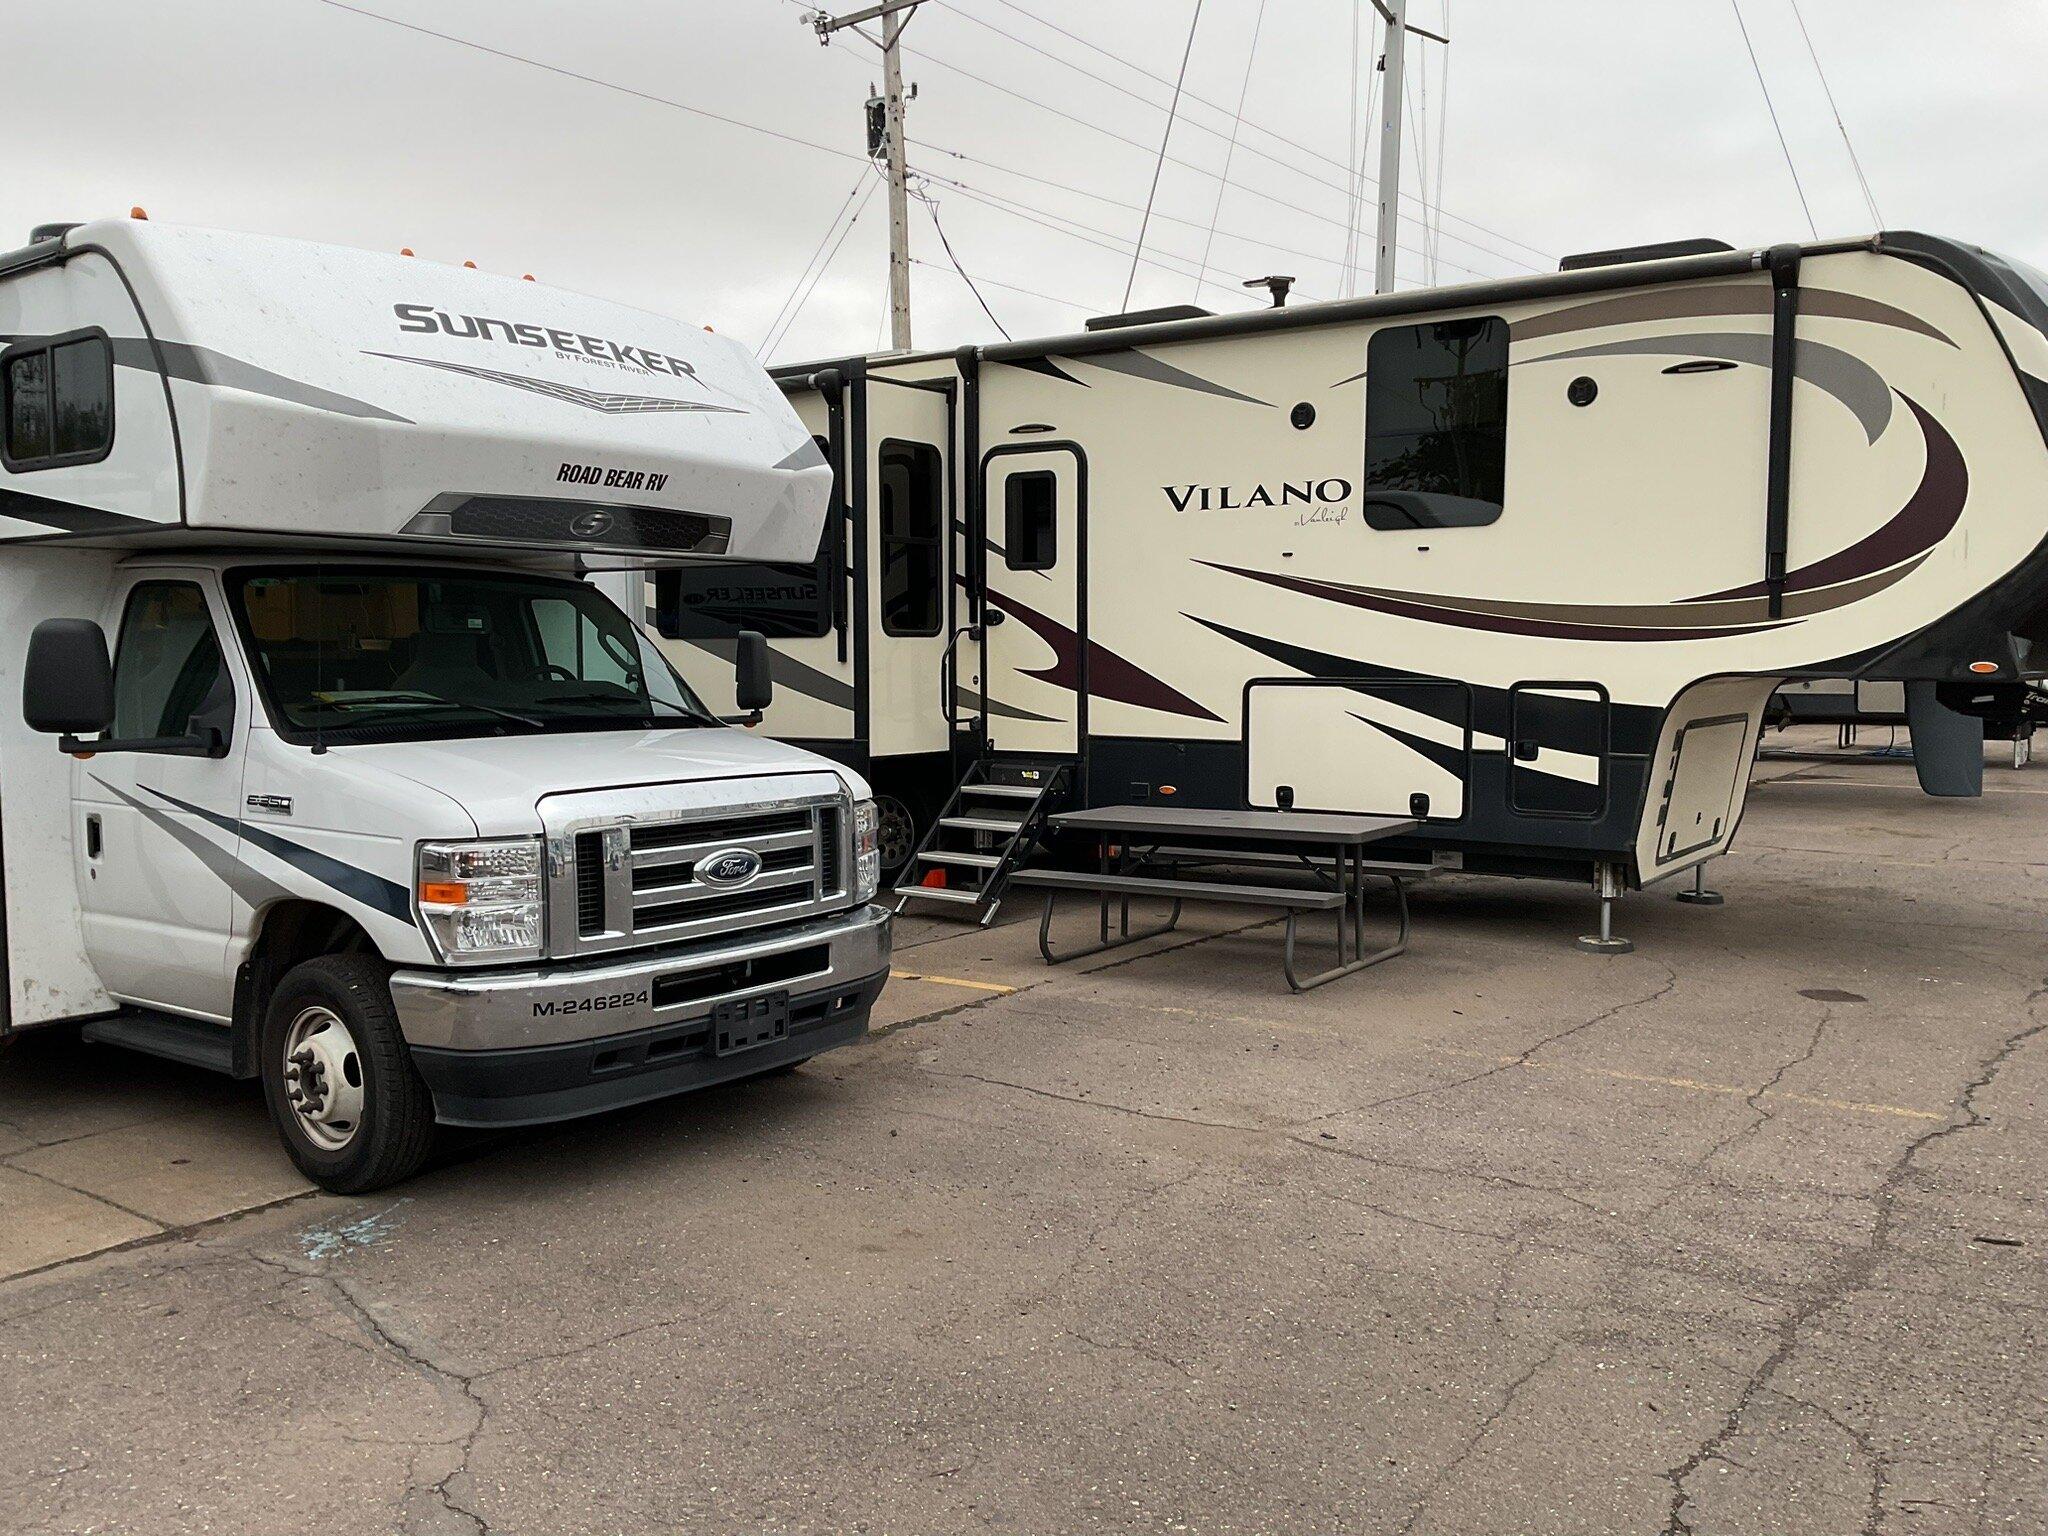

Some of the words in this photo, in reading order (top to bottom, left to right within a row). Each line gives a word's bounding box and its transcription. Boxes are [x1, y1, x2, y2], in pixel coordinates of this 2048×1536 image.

[556, 351, 571, 361] BY
[575, 354, 616, 369] FOREST
[619, 363, 650, 376] RIVER
[557, 463, 602, 485] ROAD
[604, 469, 645, 490] BEAR
[645, 473, 669, 492] RV
[1161, 478, 1351, 512] VILANO
[720, 859, 748, 876] Ford
[533, 991, 648, 1017] M-246224
